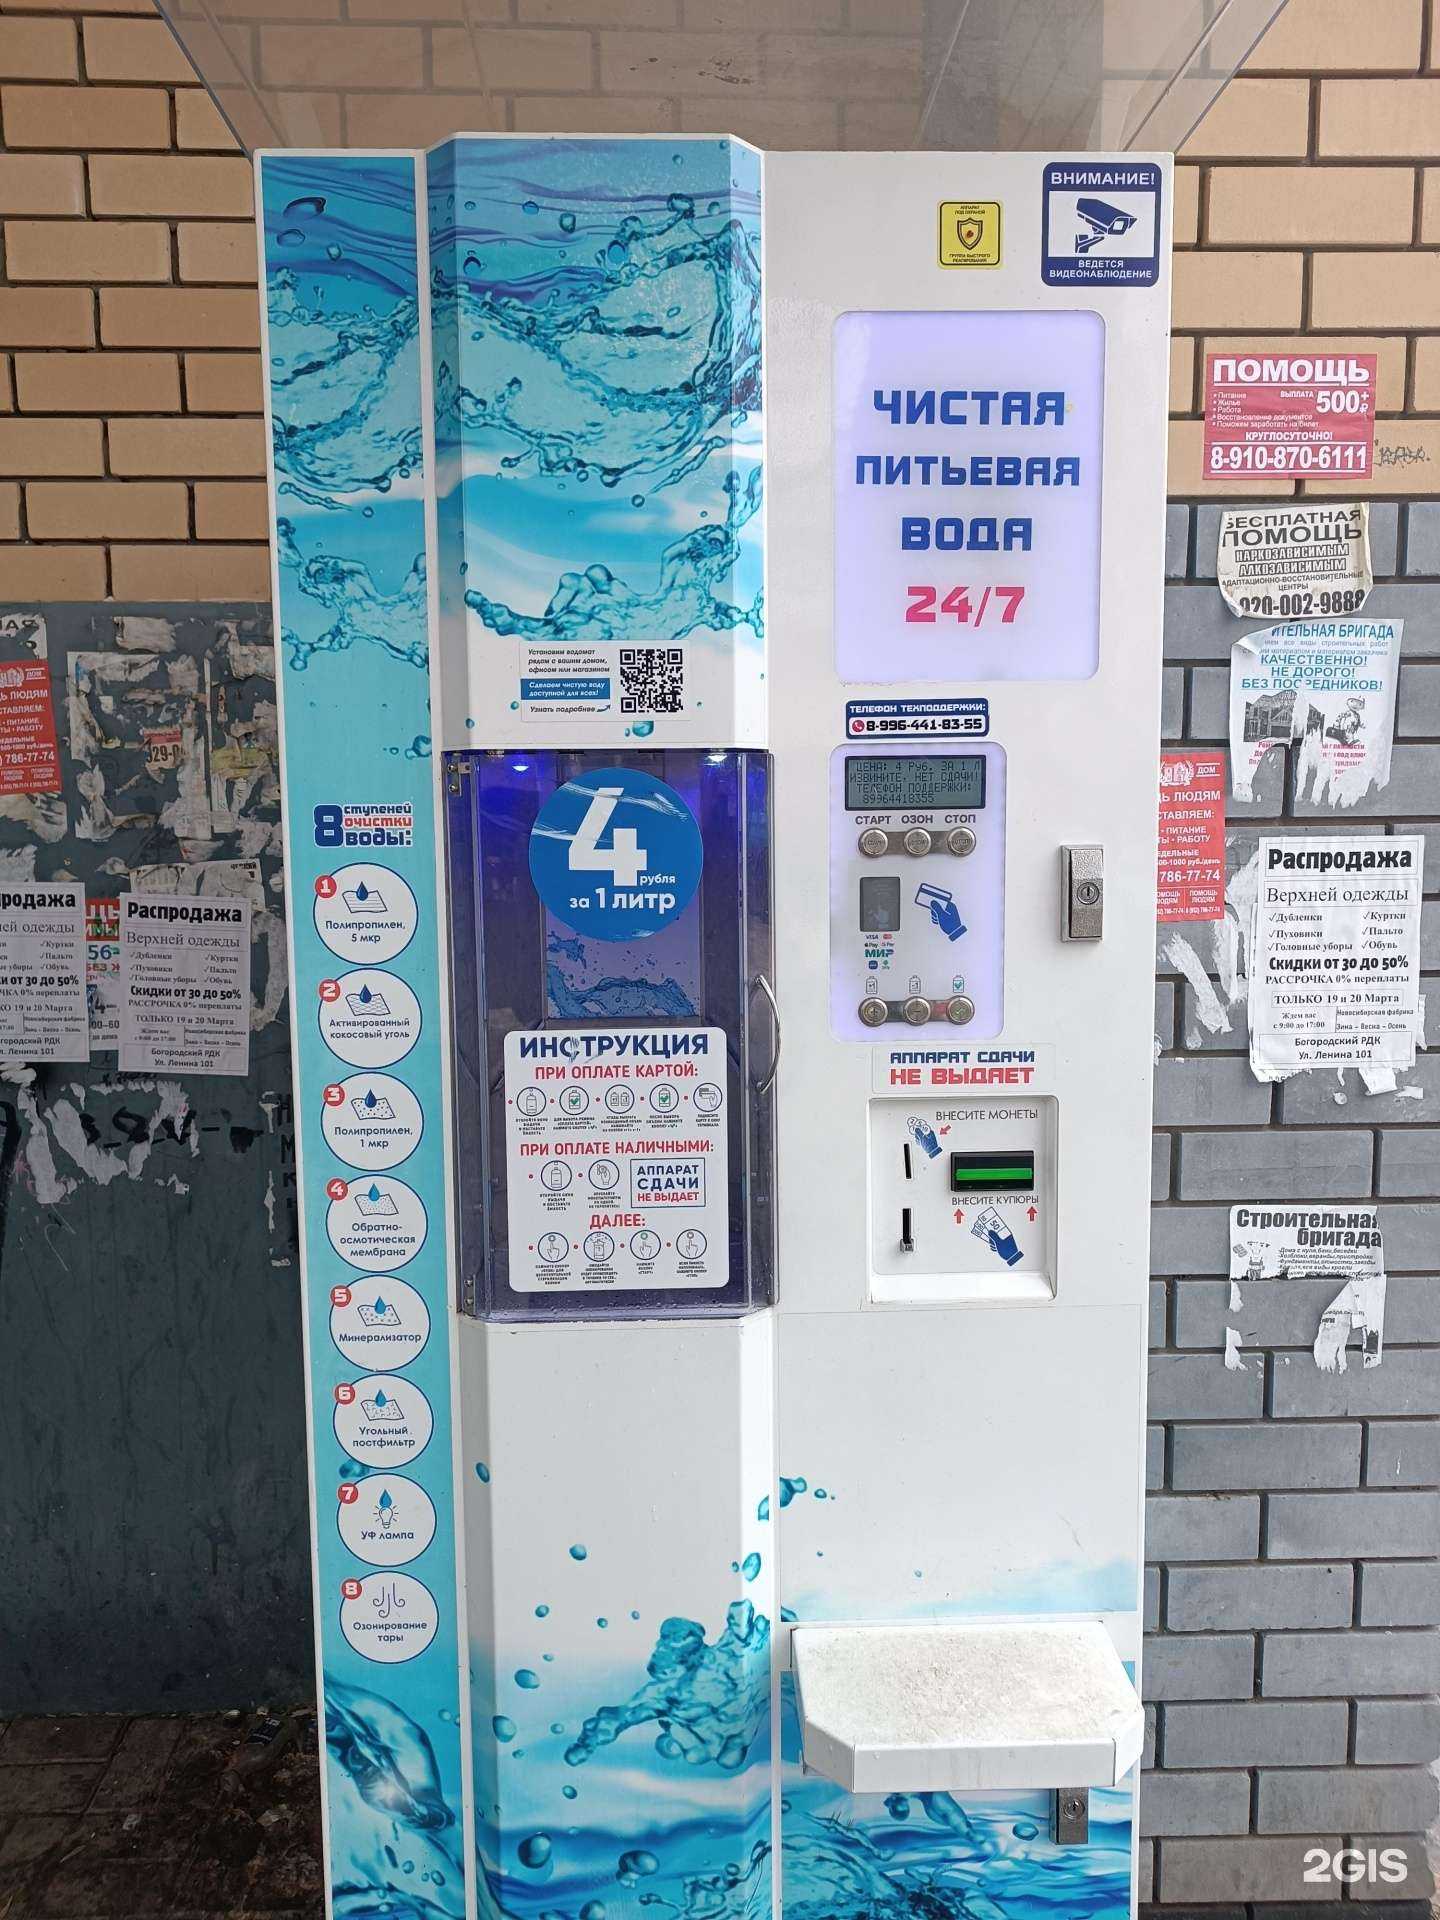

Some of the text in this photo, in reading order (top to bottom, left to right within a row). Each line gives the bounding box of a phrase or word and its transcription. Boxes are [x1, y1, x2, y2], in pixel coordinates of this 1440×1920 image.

[1051, 172, 1155, 185] ВНИМАНИЕ!
[1078, 260, 1124, 268] ВЕДЕТСЯ
[1050, 269, 1152, 279] ВИДЕОНАБЛЮДЕНИЕ
[1214, 359, 1369, 386] ПОМОЩЬ
[874, 390, 1064, 426] ЧИСТАЯ
[1246, 432, 1332, 441] КРУГЛОСУТОЧНО!
[1211, 446, 1366, 469] 8-910-870-6111
[856, 456, 1080, 486] ПИТЬЕВАЯ
[901, 517, 1033, 551] ВОДА
[1223, 524, 1362, 547] ПОМОЩЬ
[1235, 543, 1349, 562] НАРКОЗАВИСИМЫМ
[1239, 558, 1346, 577] АЛКОЗАВИСИМЫМ
[905, 586, 1025, 627] 24/7
[1338, 624, 1394, 640] БРИГАДА
[1261, 655, 1368, 665] КАЧЕСТВЕННО!
[1271, 667, 1355, 678] НЕ ДОРОГО!
[1242, 679, 1269, 689] БЕЗ
[556, 706, 595, 714] подробнее
[850, 704, 986, 713] ТЕЛЕФОН ТЕХПОДДЕРЖКИ:
[867, 719, 982, 731] 8-996-441-83-55
[1197, 766, 1216, 775] ДОМ
[914, 772, 934, 782] НЕТ
[1174, 791, 1220, 802] ЛЮДЯМ
[314, 803, 411, 846] 8 ступеней
[344, 817, 412, 827] очистки
[855, 814, 976, 824] СТАРТ ОЗОН СТОП
[1166, 826, 1206, 834] ПИТАНИЕ
[345, 828, 411, 845] воды:
[569, 787, 676, 886] 4 рубля
[1177, 835, 1210, 843] РАБОТУ
[1268, 849, 1412, 872] Распродажа
[1160, 869, 1220, 882] 786-77-74
[321, 879, 331, 893] 1
[569, 888, 676, 914] за 1 литр
[1267, 886, 1408, 906] Верхней одежды
[128, 902, 242, 923] Распродажа
[1276, 913, 1323, 923] Дубленки
[1370, 911, 1406, 921] Куртки
[325, 921, 405, 931] Полипропилен,
[1369, 927, 1403, 936] Пальто
[352, 934, 381, 943] 5 мкр
[1276, 929, 1323, 939] Пуховики
[127, 932, 240, 948] Верхней одежды
[1369, 941, 1398, 950] Обувь
[1275, 942, 1353, 953] Головные уборы
[865, 949, 894, 958] МИР
[1269, 955, 1408, 972] Скидки от 30 до 50%
[131, 985, 241, 1000] Скидки от 30 до 50%
[323, 983, 336, 997] 2
[1274, 994, 1323, 1005] ТОЛЬКО
[1327, 994, 1338, 1004] 19
[1350, 994, 1362, 1003] 20
[1364, 993, 1399, 1006] Марта
[329, 1018, 410, 1029] Активированный
[330, 1029, 410, 1040] кокосовый уголь
[520, 1034, 708, 1058] ИНСТРУКЦИЯ
[1295, 1036, 1381, 1047] Богородский РДК
[891, 1051, 1035, 1063] АППАРАТ СДАЧИ
[1299, 1050, 1372, 1060] Ул. Ленина 101
[535, 1061, 698, 1080] ПРИ ОПЛАТЕ КАРТОЙ:
[891, 1067, 1034, 1085] НЕ ВЫДАЕТ
[328, 1088, 340, 1101] 3
[936, 1109, 1038, 1121] ВНЕСИТЕ МОНЕТЫ
[334, 1127, 413, 1138] Полипропилен,
[368, 1140, 389, 1149] мкр
[520, 1140, 714, 1156] ПРИ ОПЛАТЕ НАЛИЧНЫМИ:
[637, 1165, 699, 1176] АППАРАТ
[330, 1182, 343, 1195] 4
[637, 1177, 699, 1191] СДАЧИ
[637, 1192, 699, 1202] НЕ ВЫДАЕТ
[952, 1195, 1039, 1206] ВНЕСИТЕ КУПЮРЫ
[352, 1223, 402, 1232] Обратно-
[590, 1214, 646, 1230] ДАЛЕЕ:
[340, 1236, 416, 1244] осмотическая
[1297, 1228, 1381, 1248] бригада
[350, 1248, 406, 1258] мембрана
[334, 1290, 346, 1302] 5
[339, 1334, 422, 1344] Минерализатор
[338, 1387, 351, 1400] 6
[359, 1426, 408, 1437] Угольный
[352, 1438, 416, 1448] постфильтр
[341, 1487, 352, 1500] 7
[361, 1531, 414, 1540] УФ лампа
[346, 1583, 358, 1595] 8
[353, 1621, 427, 1632] Озонирование
[377, 1634, 404, 1643] тары
